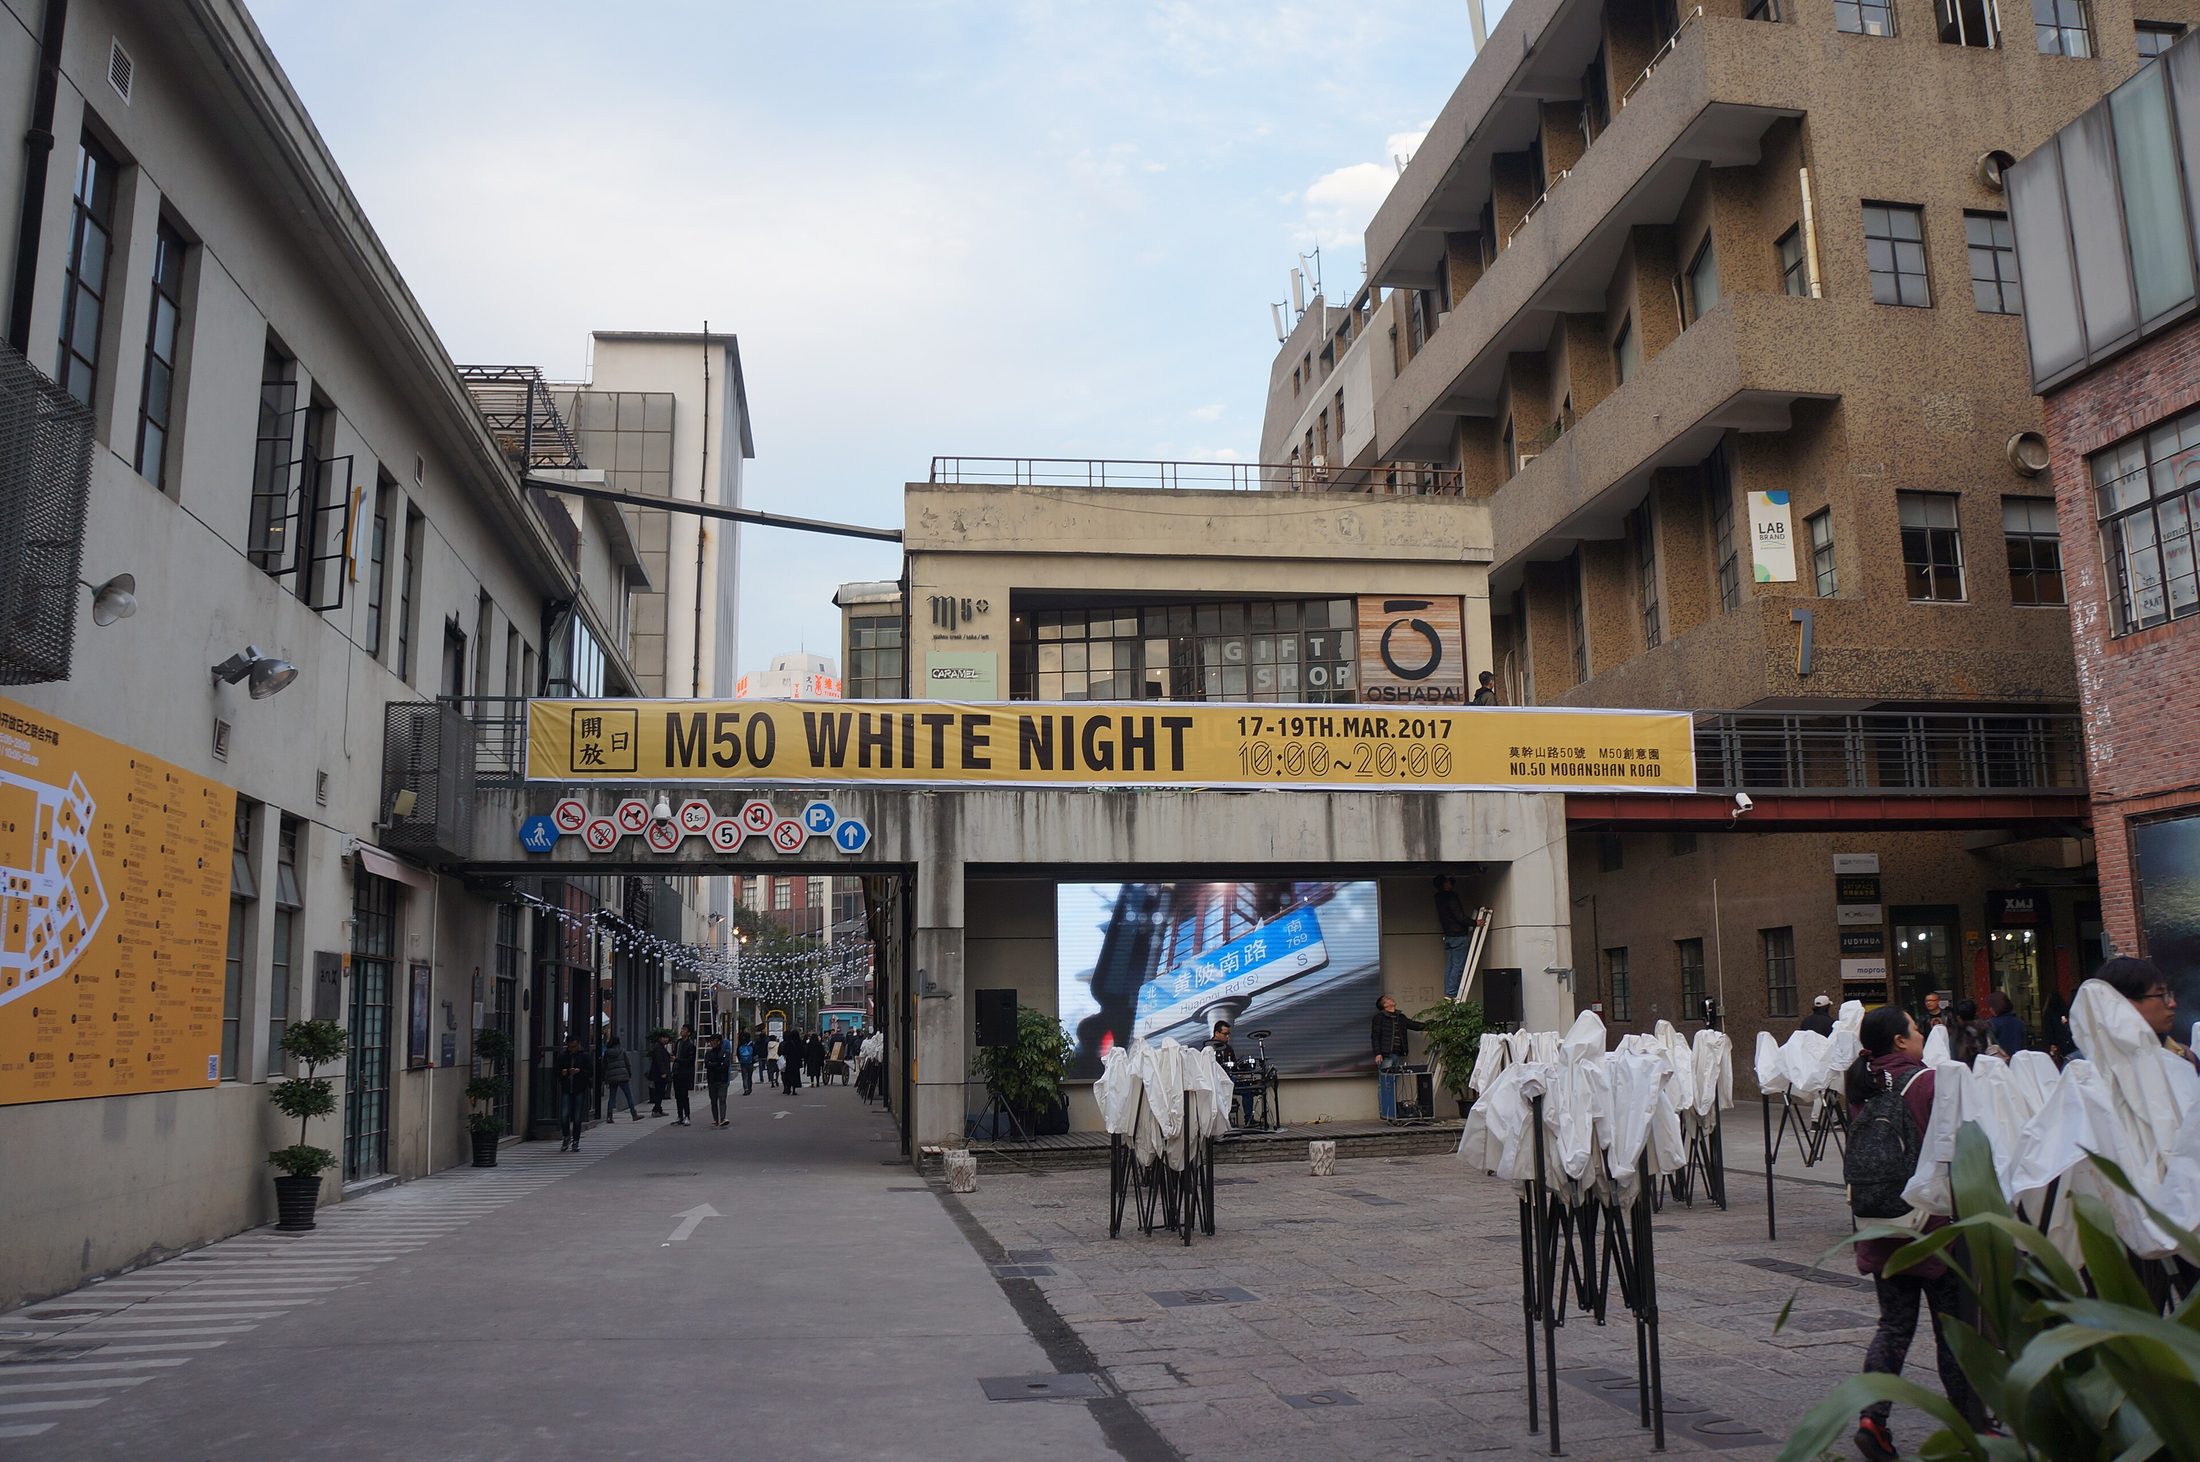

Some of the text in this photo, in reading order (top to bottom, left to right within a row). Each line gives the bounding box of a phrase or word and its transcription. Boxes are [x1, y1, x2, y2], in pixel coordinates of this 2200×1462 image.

[1758, 522, 1785, 534] LAB
[1224, 637, 1325, 661] GIFT
[1789, 608, 1814, 675] 7
[931, 667, 979, 680] CARAMEL
[1256, 665, 1351, 688] SHOP
[1367, 686, 1461, 702] OSHADAI
[1237, 716, 1453, 739] 17-19TH.MAR.2017
[665, 711, 1193, 773] M50 WHITE NIGHT
[1238, 740, 1452, 778] 10:00~20:00
[1510, 762, 1661, 778] NO.50 MOGANSHAN ROAD
[685, 812, 706, 824] 3.5m
[721, 827, 734, 845] 5
[1285, 918, 1302, 935] 南
[1286, 932, 1308, 949] 769
[1172, 938, 1268, 999] 黄陂南路
[1296, 953, 1308, 967] S
[1224, 980, 1240, 996] Rd
[1242, 973, 1259, 989] (S)
